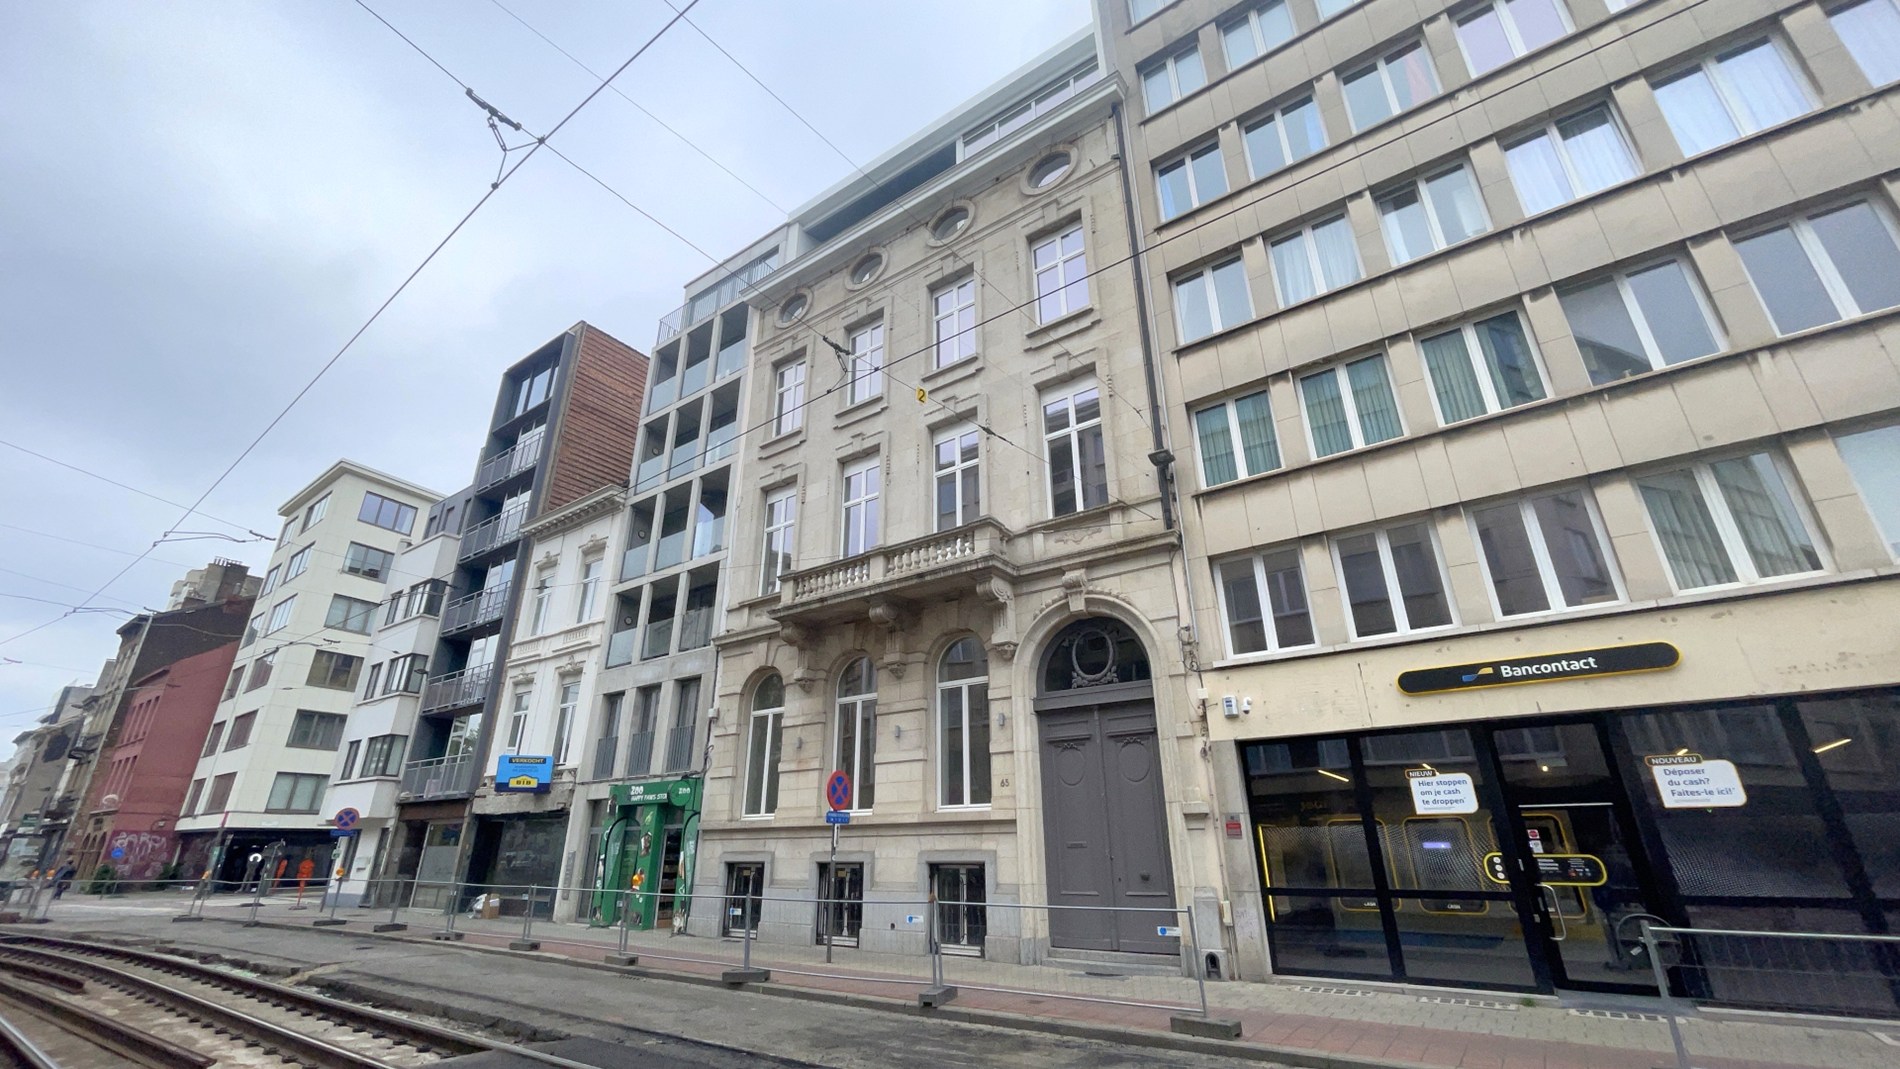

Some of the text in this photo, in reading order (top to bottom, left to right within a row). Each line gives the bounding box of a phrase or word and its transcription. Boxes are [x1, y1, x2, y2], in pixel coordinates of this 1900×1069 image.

[918, 388, 926, 403] 2
[1500, 656, 1598, 678] Bancontact
[1651, 756, 1697, 765] NOUVEAU
[1663, 768, 1705, 777] Déposer
[1000, 778, 1010, 787] 65
[1436, 779, 1468, 787] stoppen
[1682, 777, 1710, 786] cash?
[630, 785, 644, 796] ZOO
[678, 787, 691, 795] ZOO
[1434, 789, 1442, 797] je
[1670, 788, 1714, 797] Faites-le
